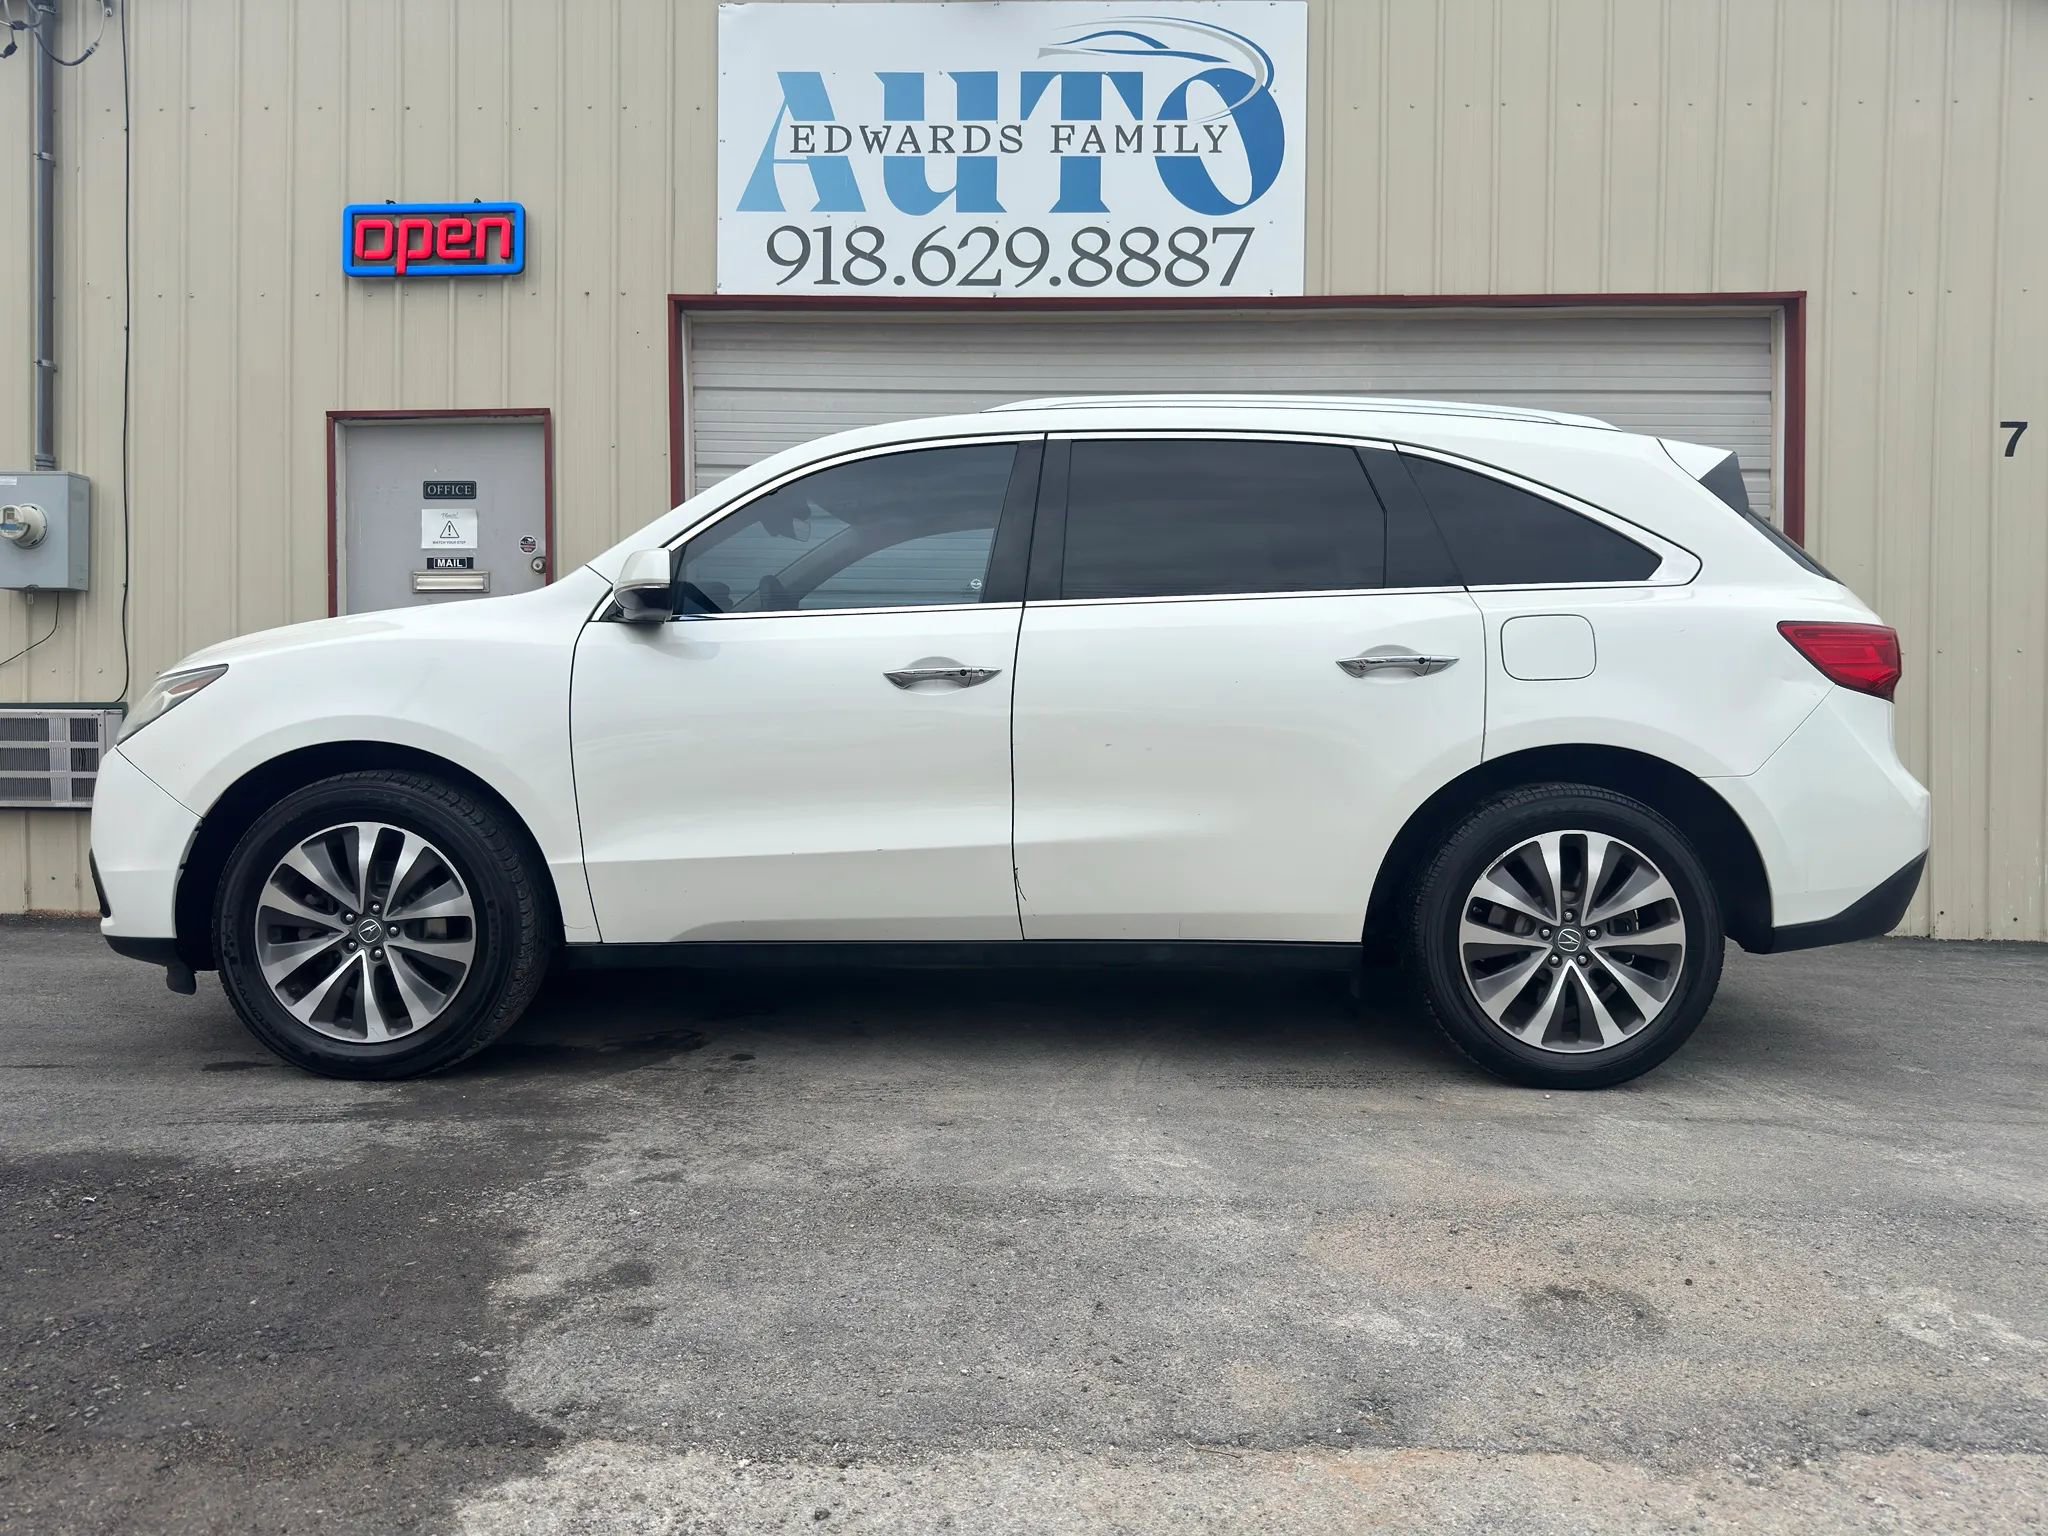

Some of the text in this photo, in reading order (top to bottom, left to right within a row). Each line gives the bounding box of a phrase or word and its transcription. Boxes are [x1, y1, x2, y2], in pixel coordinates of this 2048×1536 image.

[736, 67, 1285, 216] AUTO
[789, 124, 1229, 155] EDWARDS FAMILY
[354, 217, 512, 276] open
[766, 225, 1256, 288] 918.629.8887
[1999, 421, 2028, 457] 7
[427, 485, 472, 495] OFFICE
[437, 559, 463, 567] MAIL
